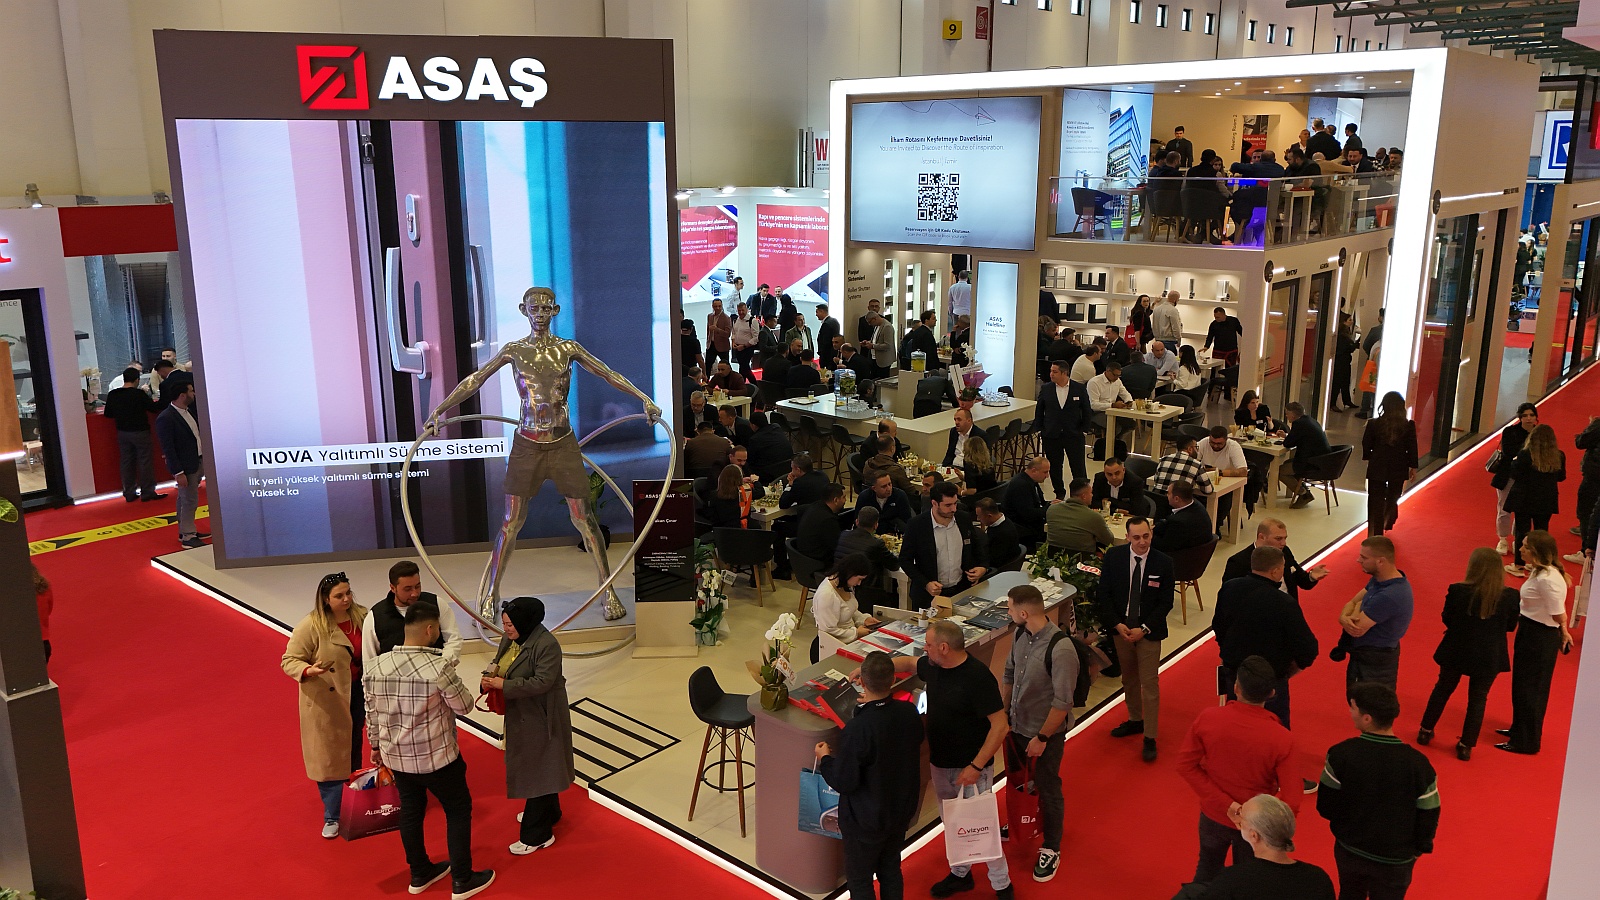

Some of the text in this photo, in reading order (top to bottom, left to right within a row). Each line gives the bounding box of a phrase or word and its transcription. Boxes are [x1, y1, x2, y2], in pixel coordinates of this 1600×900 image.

[949, 24, 956, 35] 9
[378, 56, 548, 108] ASAŞ
[252, 440, 505, 465] INOVA Yalıtımlı Süme Sistemi
[262, 475, 284, 488] yerli
[284, 473, 320, 486] yüksek
[321, 472, 360, 485] yalıtımlı
[362, 470, 393, 481] sürme
[250, 487, 300, 499] Yüksek ka
[966, 825, 989, 834] vizyon
